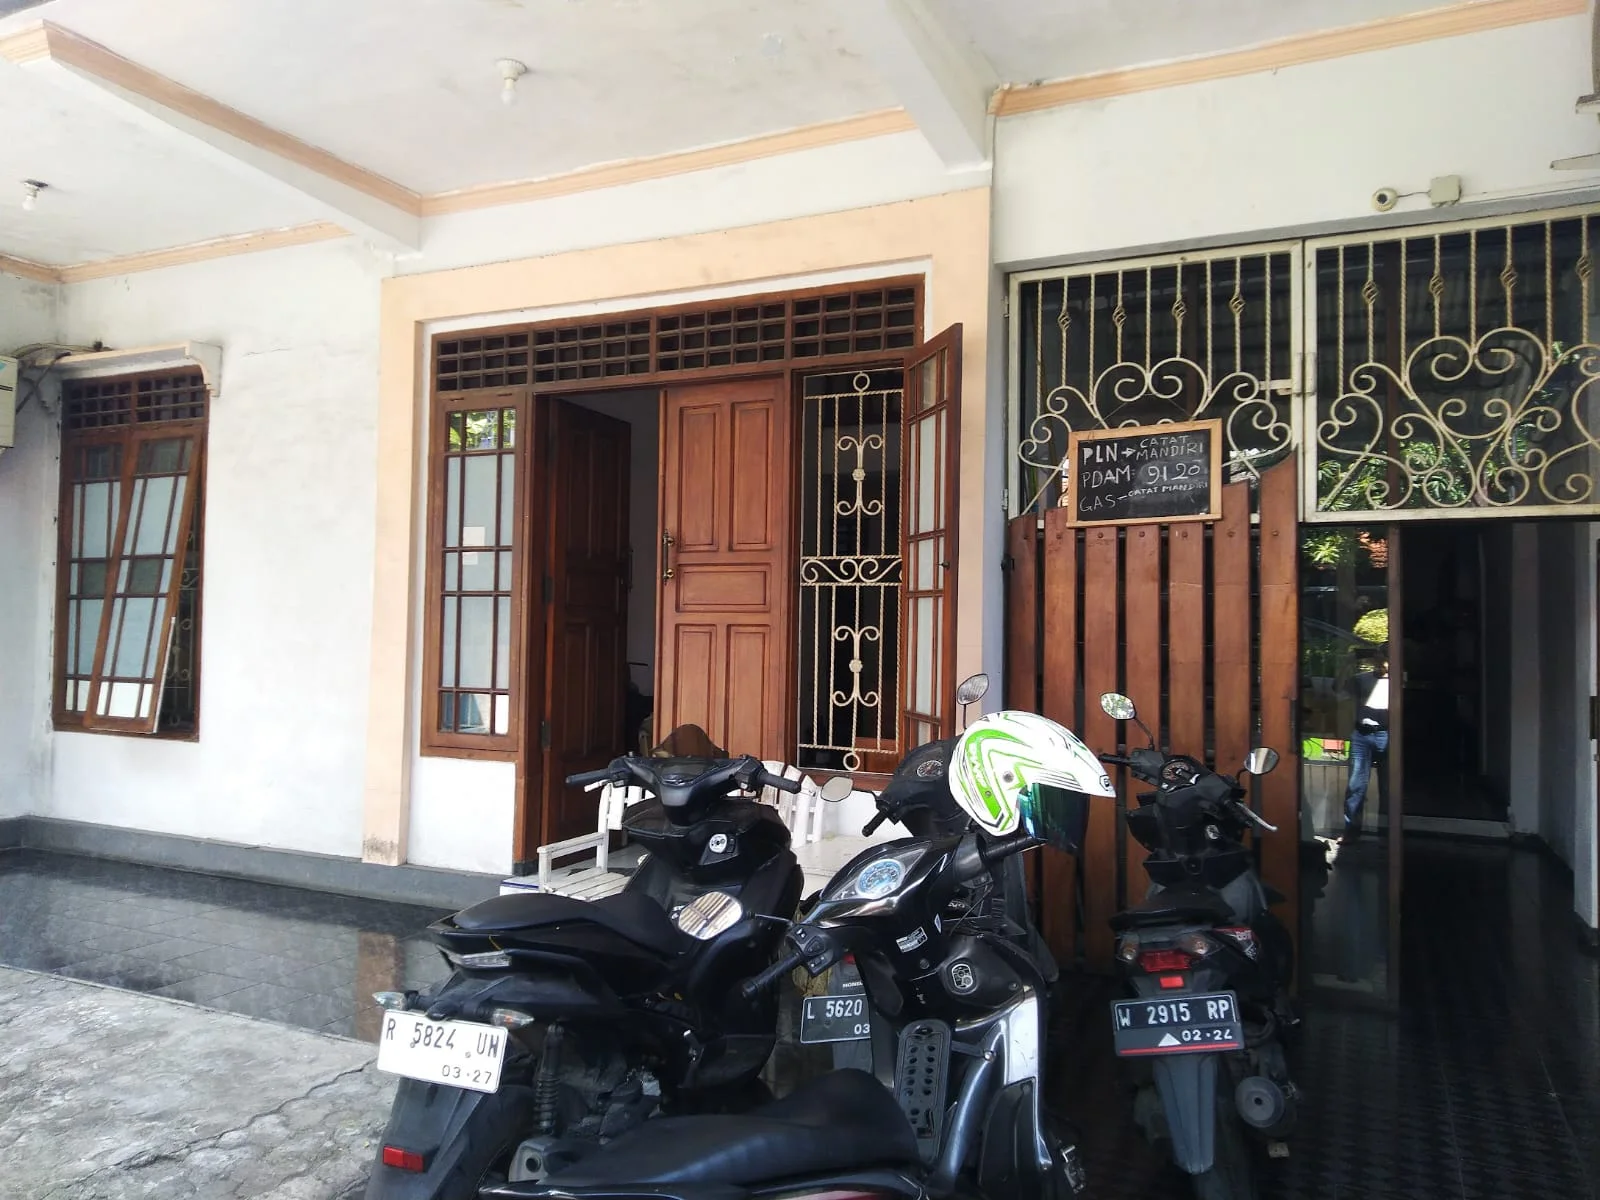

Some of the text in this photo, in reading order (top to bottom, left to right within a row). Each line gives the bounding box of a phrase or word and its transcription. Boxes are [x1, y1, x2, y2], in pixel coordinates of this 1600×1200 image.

[1139, 435, 1189, 449] CATAT
[1083, 442, 1203, 465] PLN MANDIRI
[1079, 494, 1117, 512] GAS
[806, 999, 863, 1019] L 5620
[1118, 999, 1229, 1027] W 2915 RP
[386, 1018, 396, 1040] R
[411, 1022, 456, 1049] 5824
